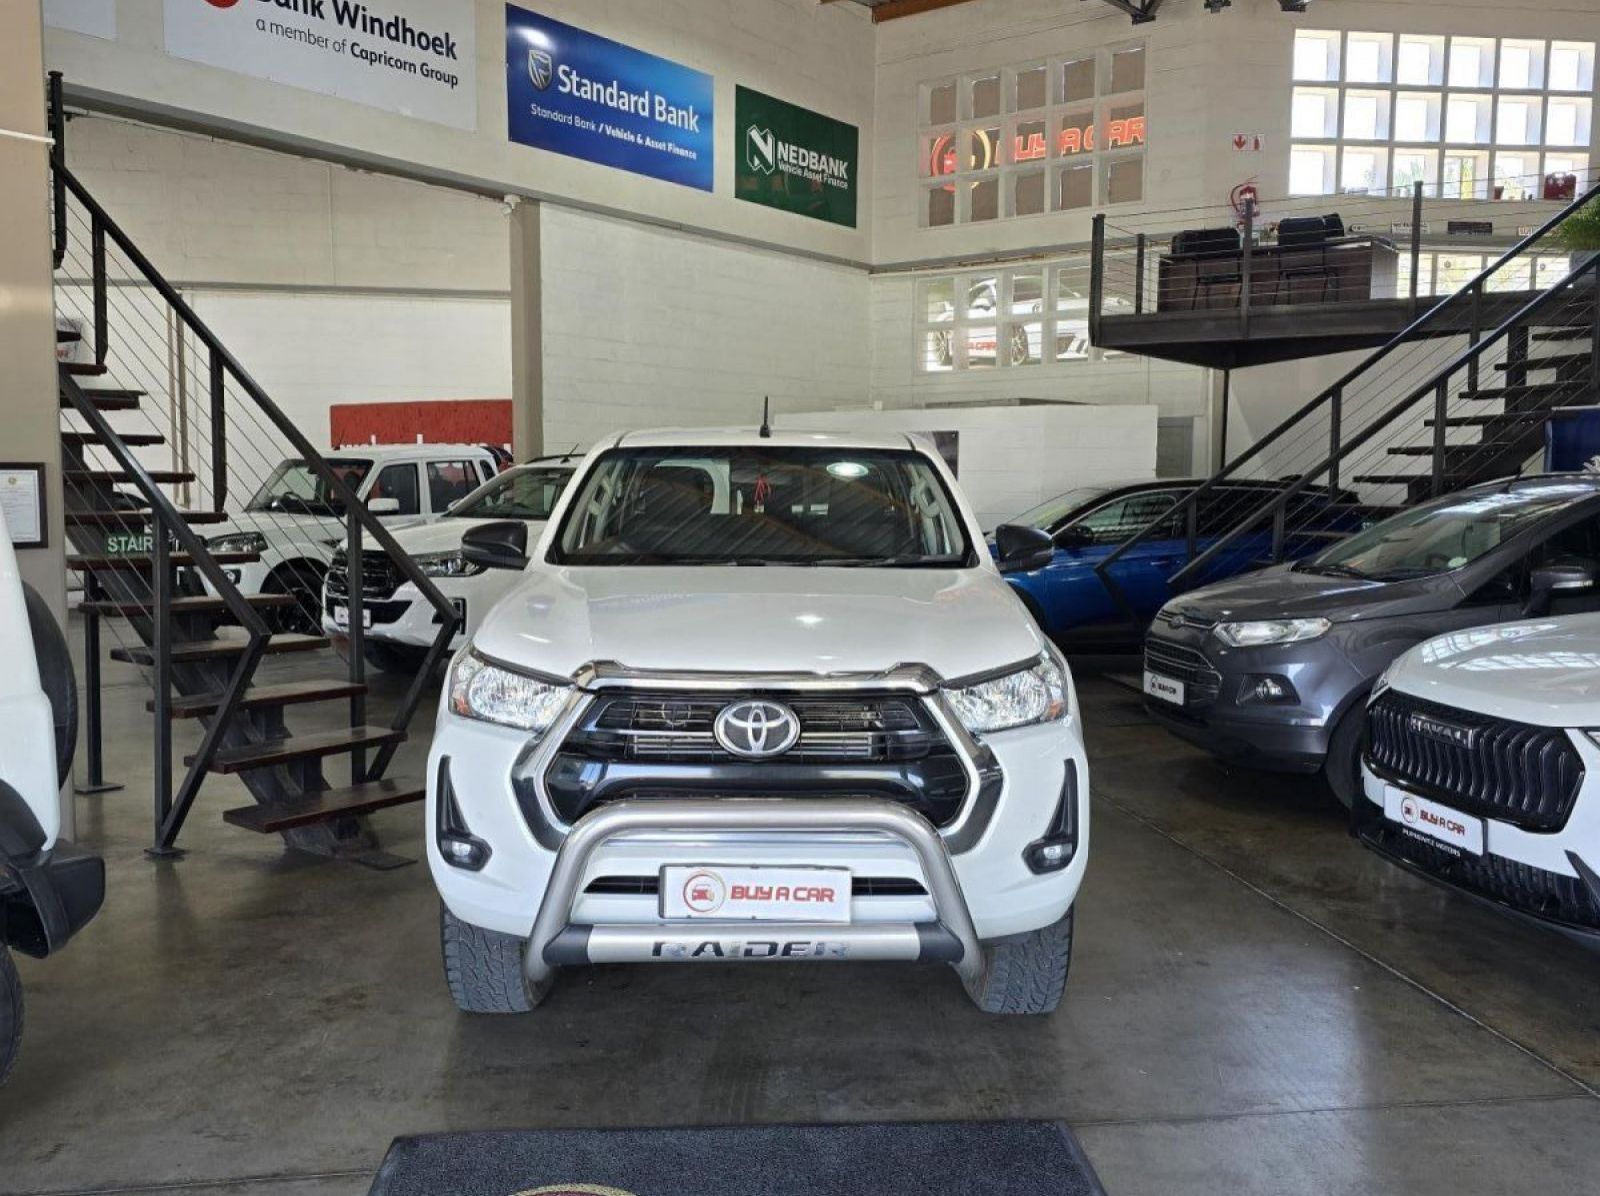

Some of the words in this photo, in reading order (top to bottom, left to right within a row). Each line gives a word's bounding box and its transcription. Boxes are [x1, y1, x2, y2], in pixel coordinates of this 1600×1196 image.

[257, 0, 325, 20] ank
[331, 0, 458, 60] Windhoek
[255, 18, 266, 32] a
[269, 21, 329, 49] member
[332, 39, 347, 54] of
[350, 42, 417, 75] Capricorn
[420, 62, 459, 90] Group
[557, 64, 650, 118] Standard
[654, 94, 700, 133] Bank
[530, 103, 573, 126] Standard
[574, 115, 597, 132] Bank
[605, 124, 635, 143] Vehicle
[636, 133, 644, 145] &
[644, 136, 667, 152] Asset
[667, 142, 698, 160] Finance
[776, 141, 849, 180] NEDBANK
[779, 159, 802, 176] Vehicle
[803, 167, 822, 183] Asset
[823, 173, 849, 190] Finance
[1420, 809, 1438, 825] BUY
[1447, 819, 1465, 836] CAR
[730, 885, 773, 901] BUY
[775, 886, 790, 901] A
[793, 886, 835, 903] CAR
[651, 940, 850, 958] RAIDER
